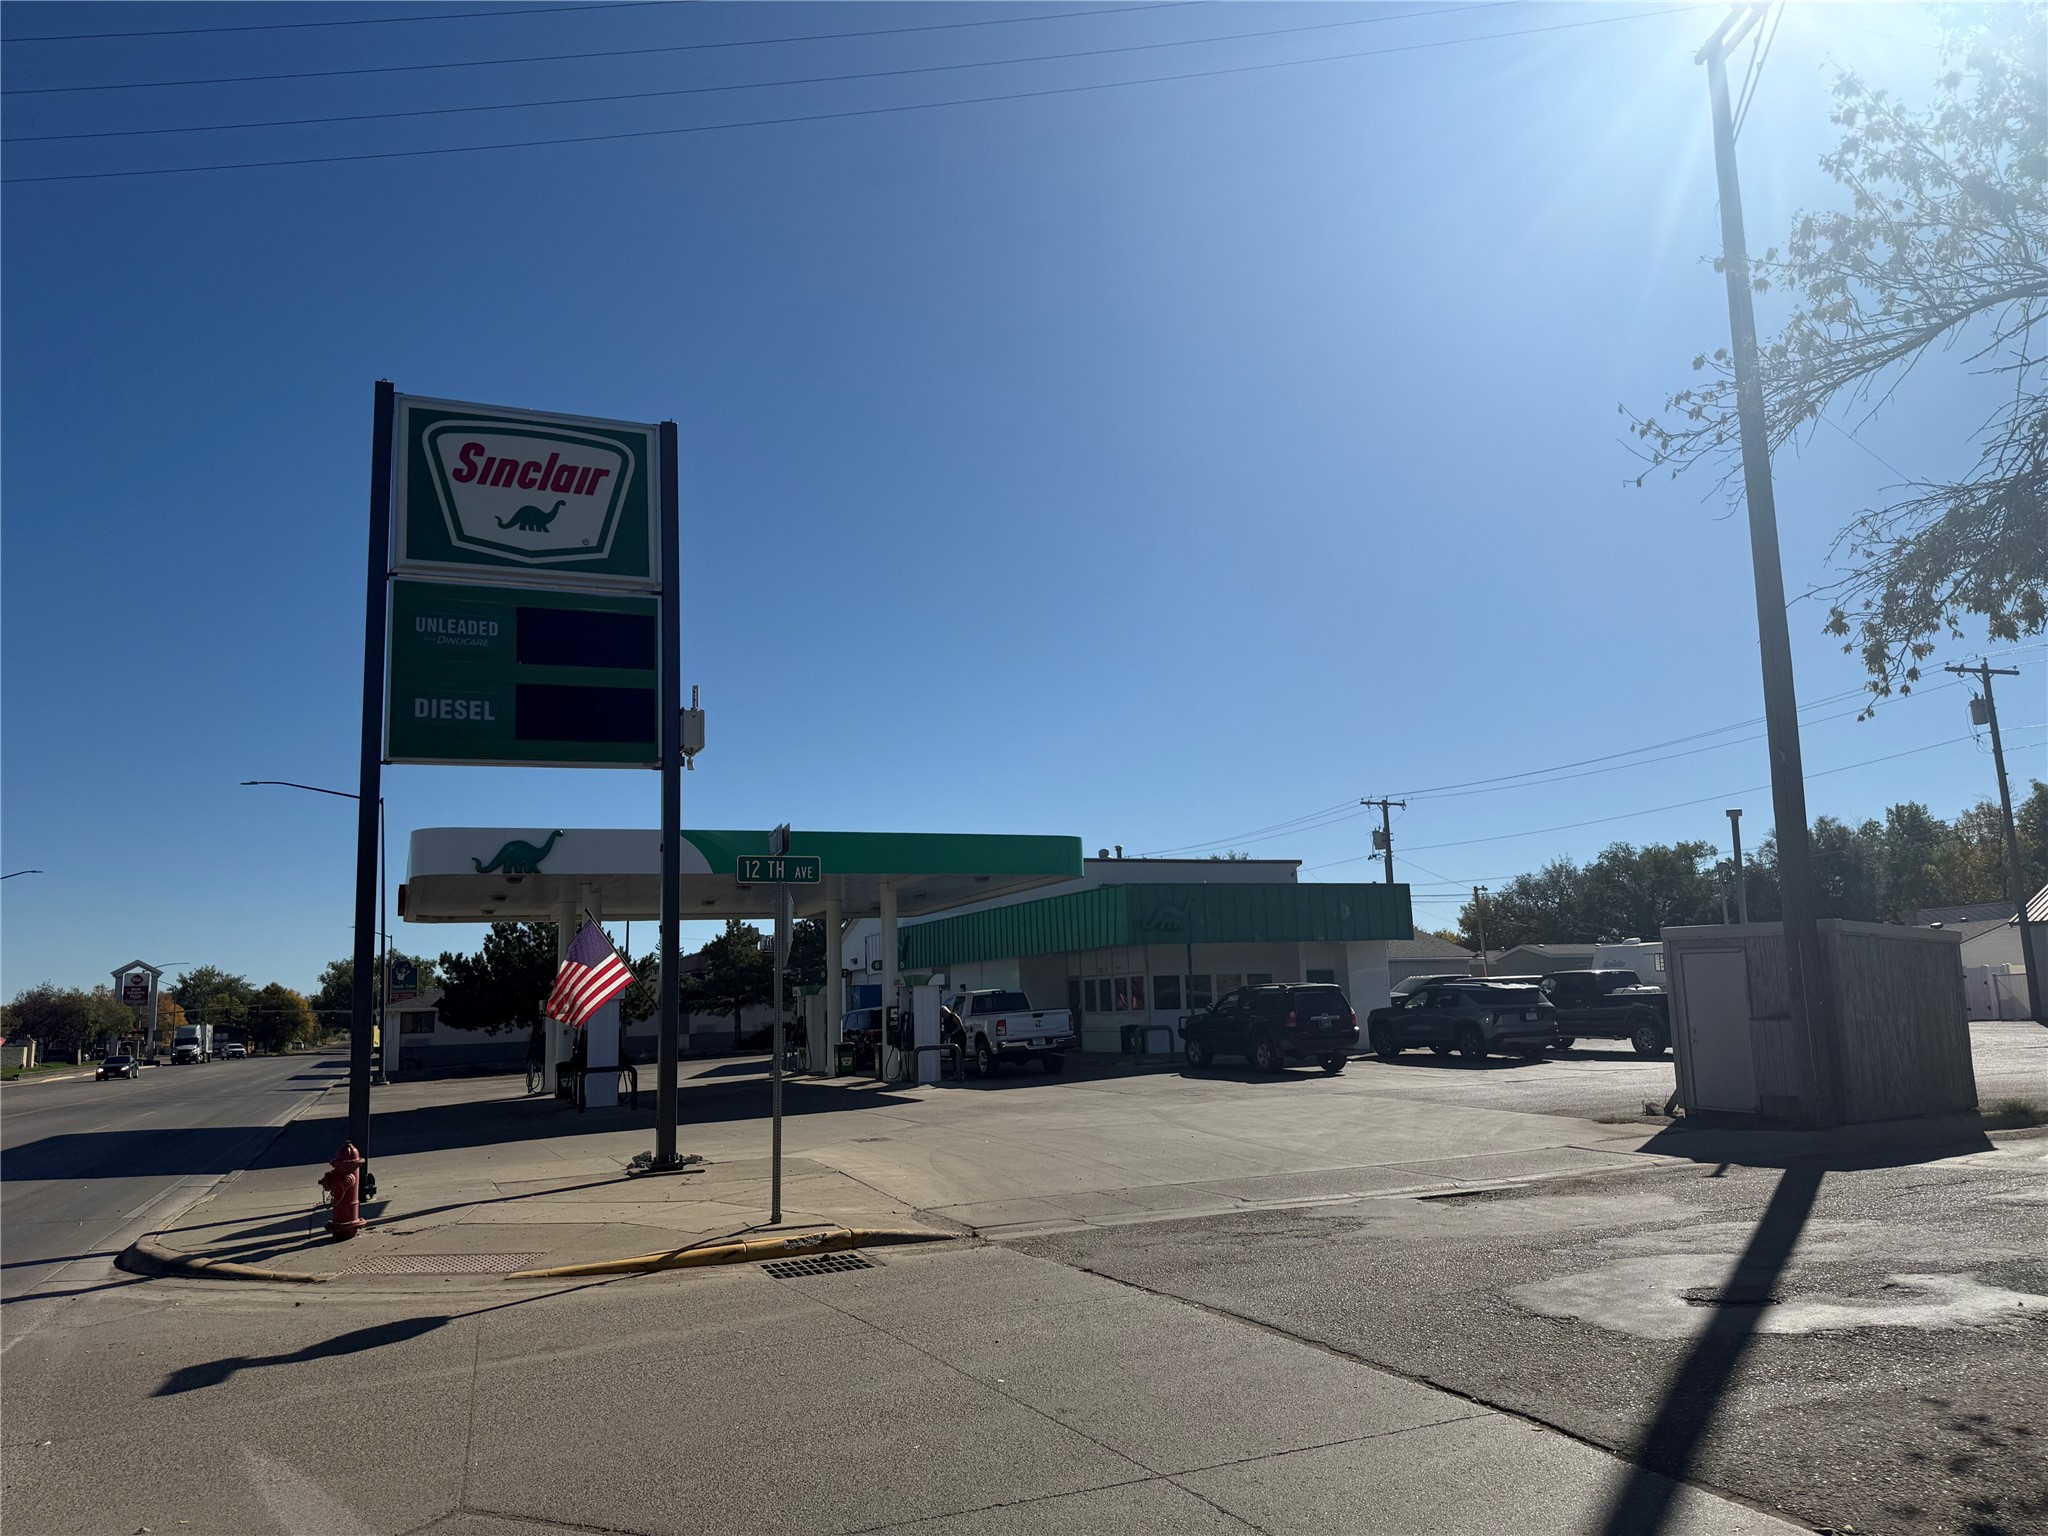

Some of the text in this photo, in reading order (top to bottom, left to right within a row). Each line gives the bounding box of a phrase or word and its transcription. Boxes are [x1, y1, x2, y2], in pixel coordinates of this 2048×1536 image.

[451, 442, 610, 496] Sinclair
[415, 616, 499, 637] UNLEADED
[436, 635, 490, 647] DINOCARE
[414, 697, 496, 721] DIESEL
[745, 860, 813, 879] 12 TH AVE
